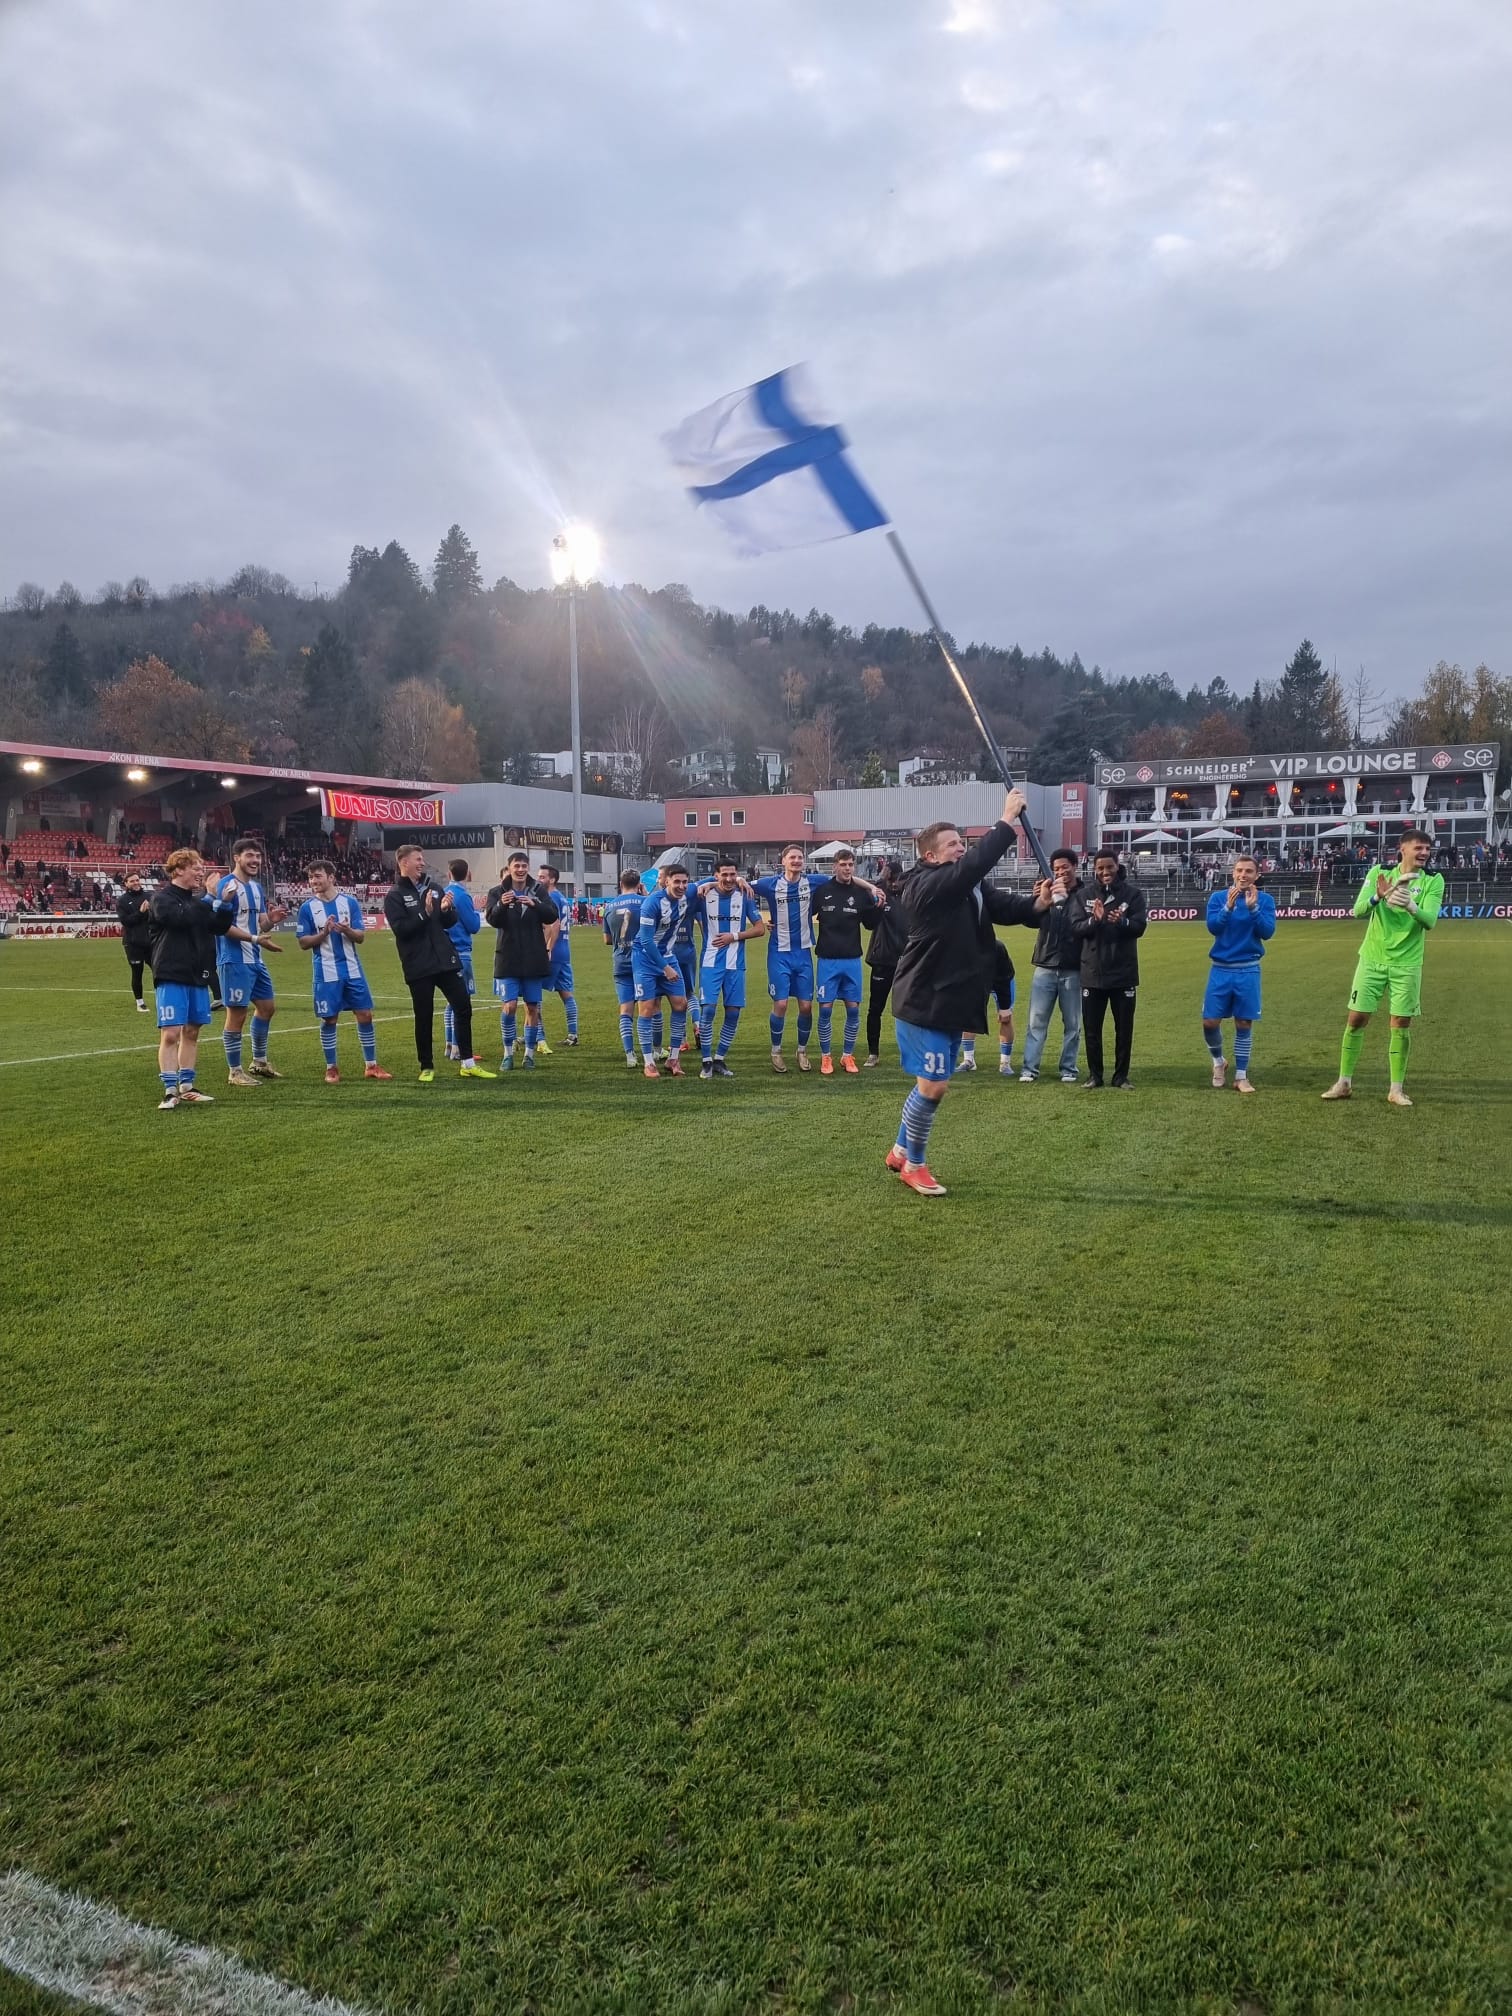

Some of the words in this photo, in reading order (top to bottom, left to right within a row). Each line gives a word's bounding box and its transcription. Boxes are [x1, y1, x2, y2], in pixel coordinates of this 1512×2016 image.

[134, 754, 160, 765] ARENA
[1270, 758, 1308, 776] VIP
[1316, 752, 1417, 774] LOUNGE
[289, 769, 312, 778] ARENA
[1199, 773, 1247, 782] ENGINEERING
[333, 792, 435, 822] UNISONO
[418, 831, 486, 846] WEGMANN
[528, 828, 571, 847] Würzburger
[1148, 908, 1198, 920] GROUP
[1438, 905, 1473, 918] KRE
[615, 907, 632, 939] 7
[229, 987, 243, 1002] 19
[160, 1005, 175, 1021] 10
[315, 1000, 328, 1014] 13
[924, 1051, 945, 1075] 31
